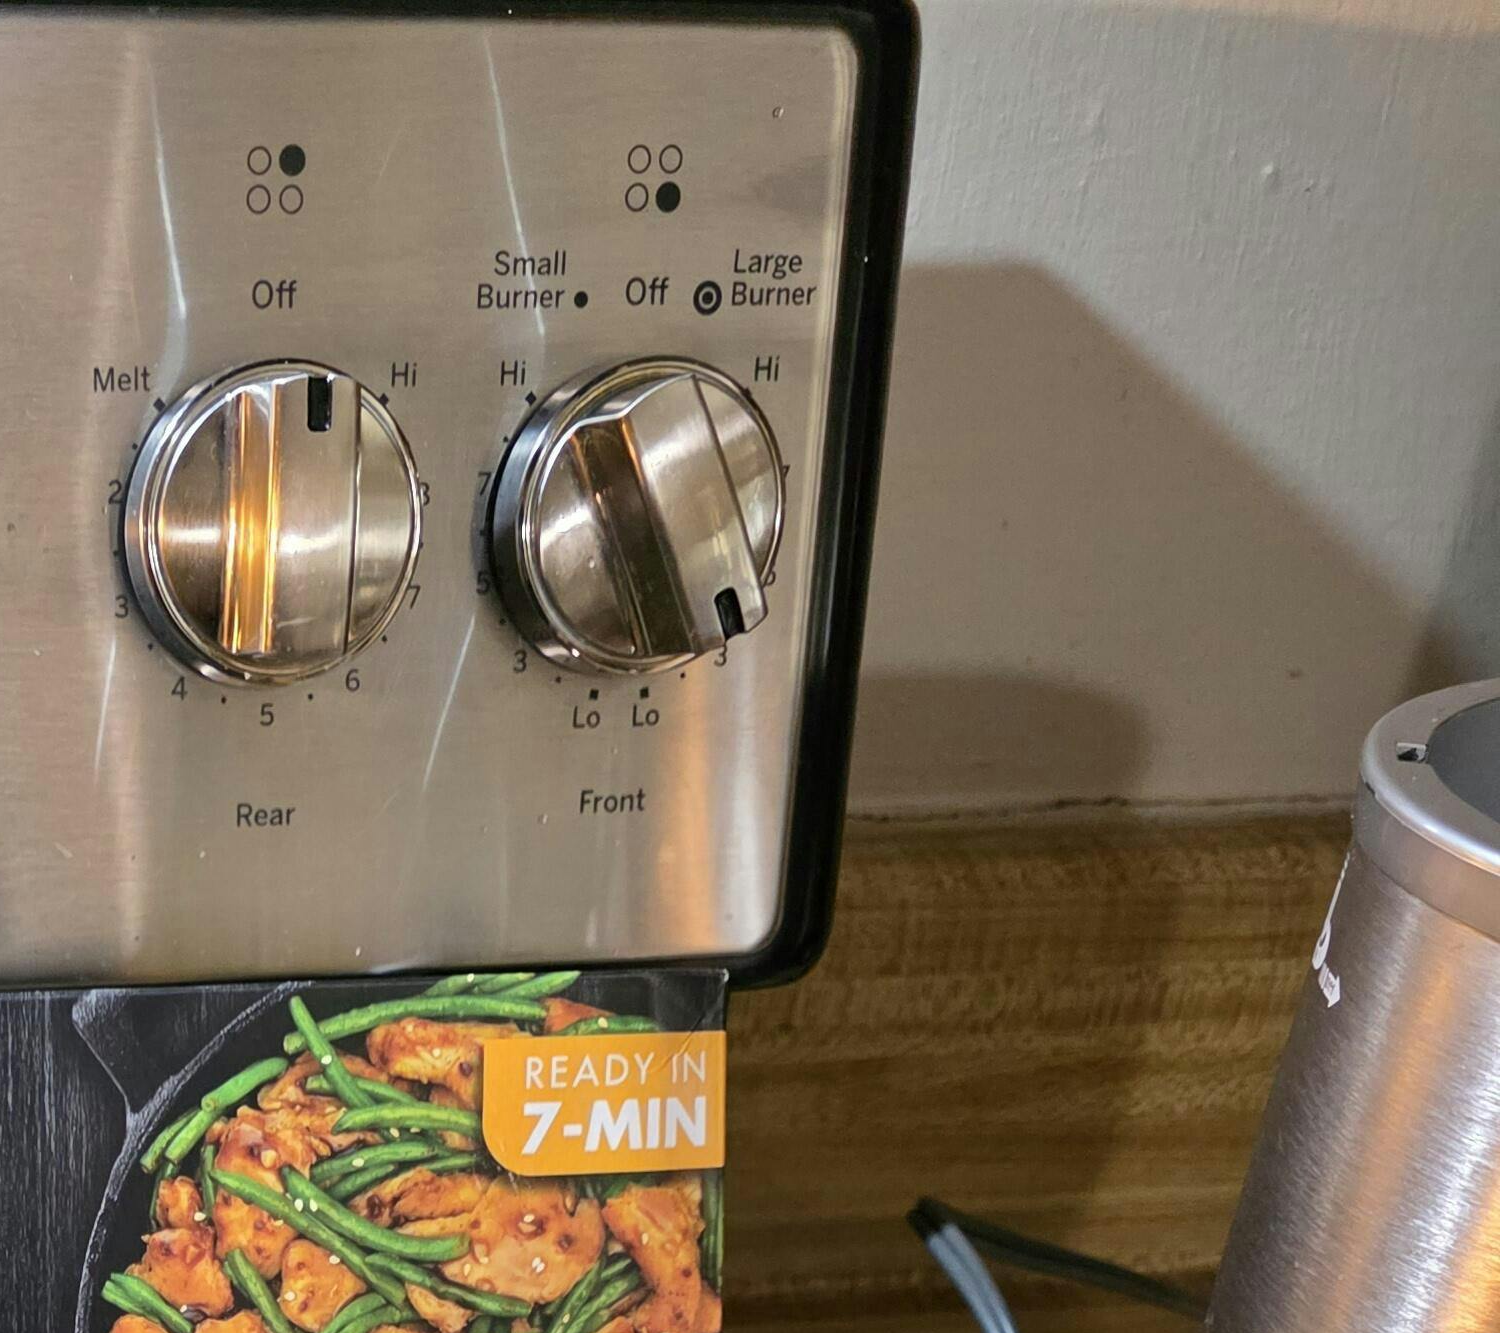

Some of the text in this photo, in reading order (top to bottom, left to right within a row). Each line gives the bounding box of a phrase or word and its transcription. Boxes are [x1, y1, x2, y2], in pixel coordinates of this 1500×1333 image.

[494, 249, 567, 276] Small
[733, 249, 803, 280] Large
[251, 279, 297, 309] Off
[477, 283, 566, 310] Burner
[625, 276, 670, 306] Off
[731, 281, 817, 306] Burner
[93, 366, 150, 392] Melt
[390, 362, 417, 388] Hi
[500, 360, 526, 386] Hi
[754, 356, 780, 382] Hi
[108, 479, 122, 504] 2
[477, 471, 492, 496] 7
[476, 572, 491, 594] 5
[115, 595, 129, 618] 3
[406, 585, 421, 609] 7
[513, 651, 527, 673] 3
[714, 645, 728, 666] 3
[171, 676, 188, 700] 4
[345, 669, 360, 691] 6
[259, 702, 275, 726] 5
[572, 705, 601, 729] Lo
[632, 704, 660, 727] Lo
[579, 788, 646, 814] Front
[236, 803, 296, 828] Rear
[525, 1050, 706, 1090] READY IN
[521, 1096, 706, 1155] 7-MIN
